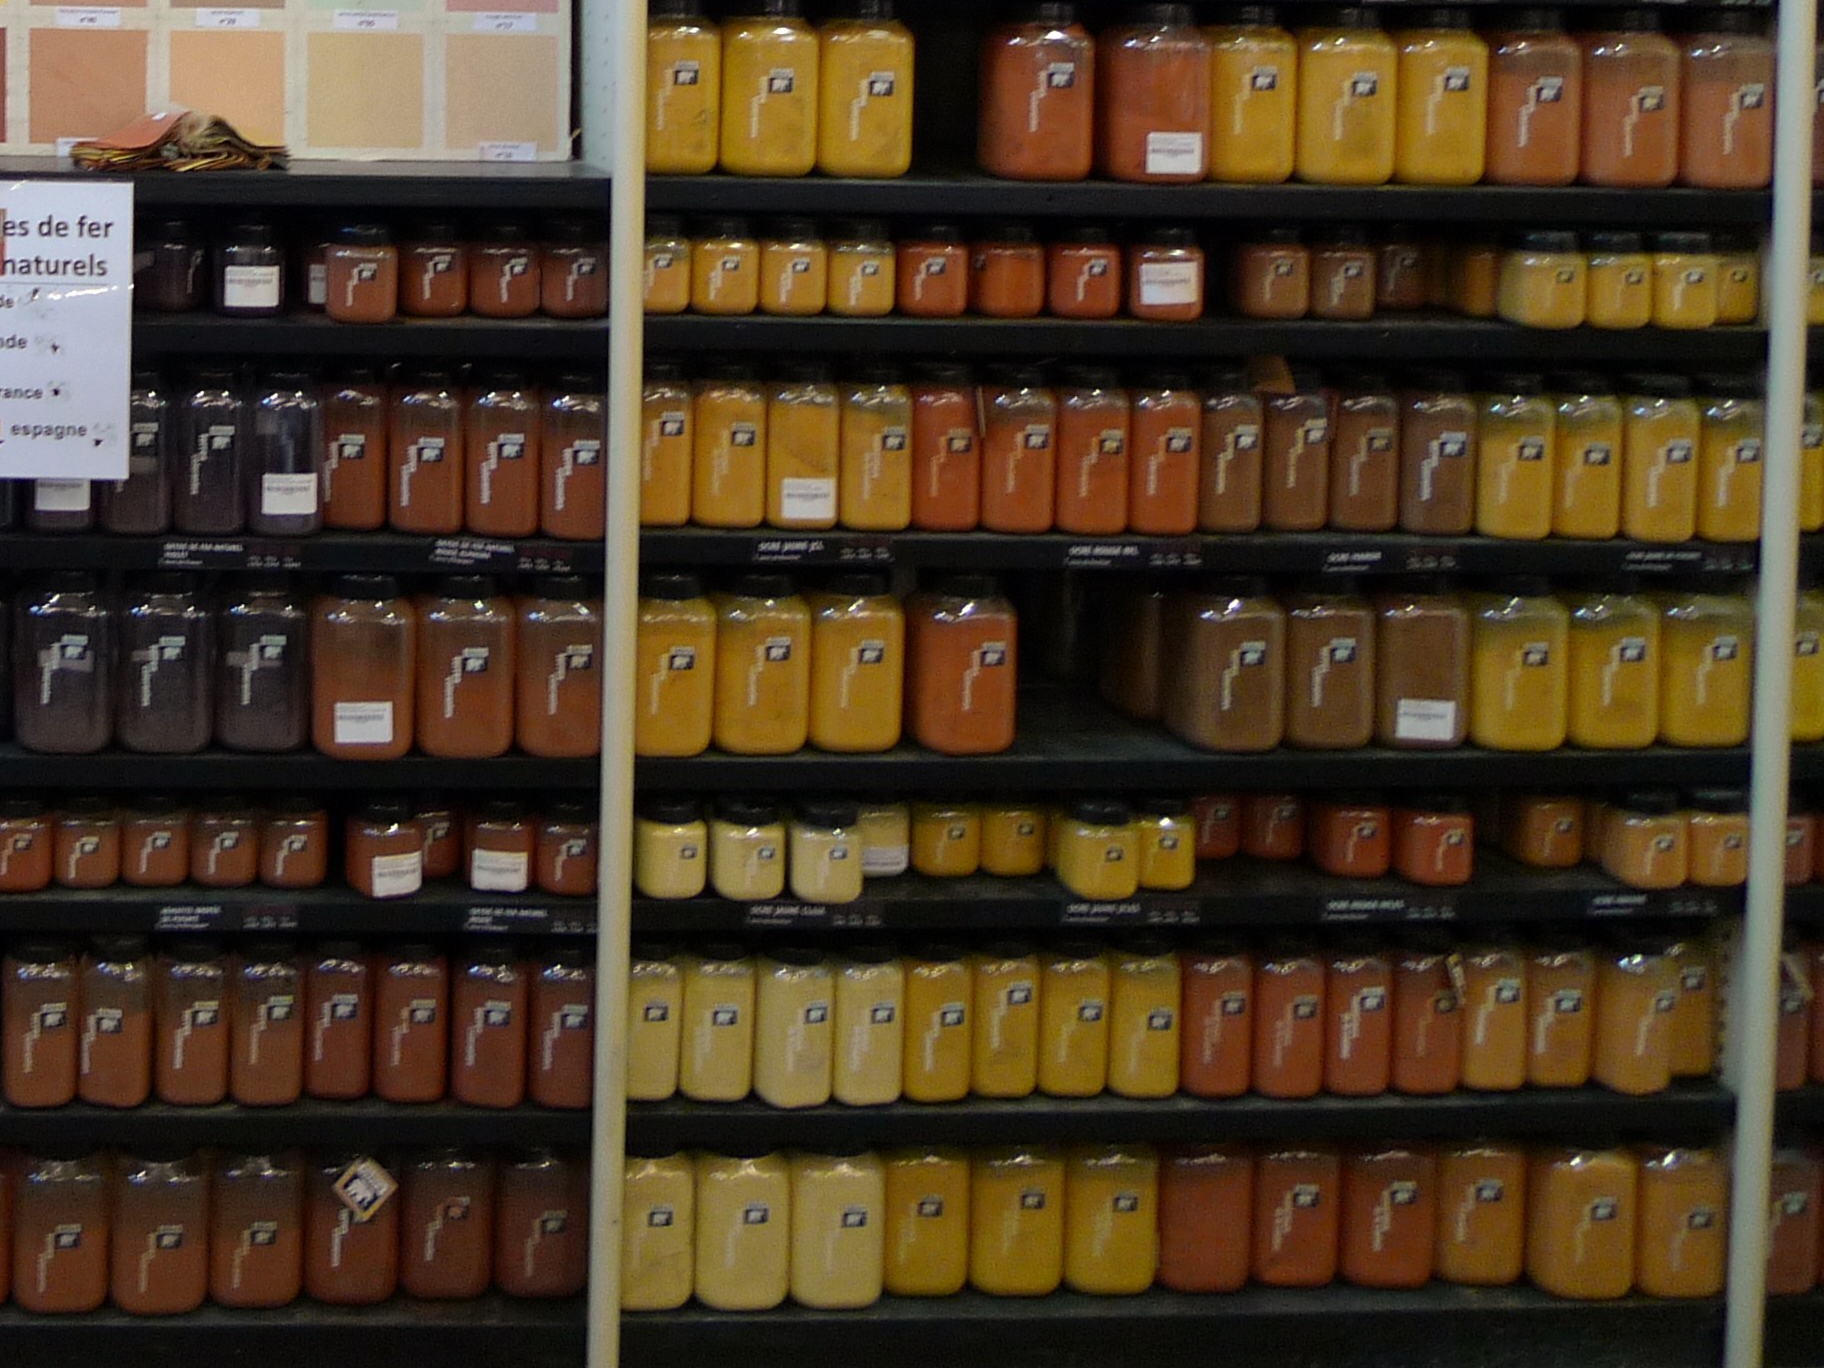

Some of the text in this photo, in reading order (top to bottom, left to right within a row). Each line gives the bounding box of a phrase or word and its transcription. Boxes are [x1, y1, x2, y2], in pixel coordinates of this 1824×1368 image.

[38, 214, 70, 238] de
[77, 214, 115, 239] fer
[2, 253, 108, 277] naturels
[10, 424, 87, 439] espagne
